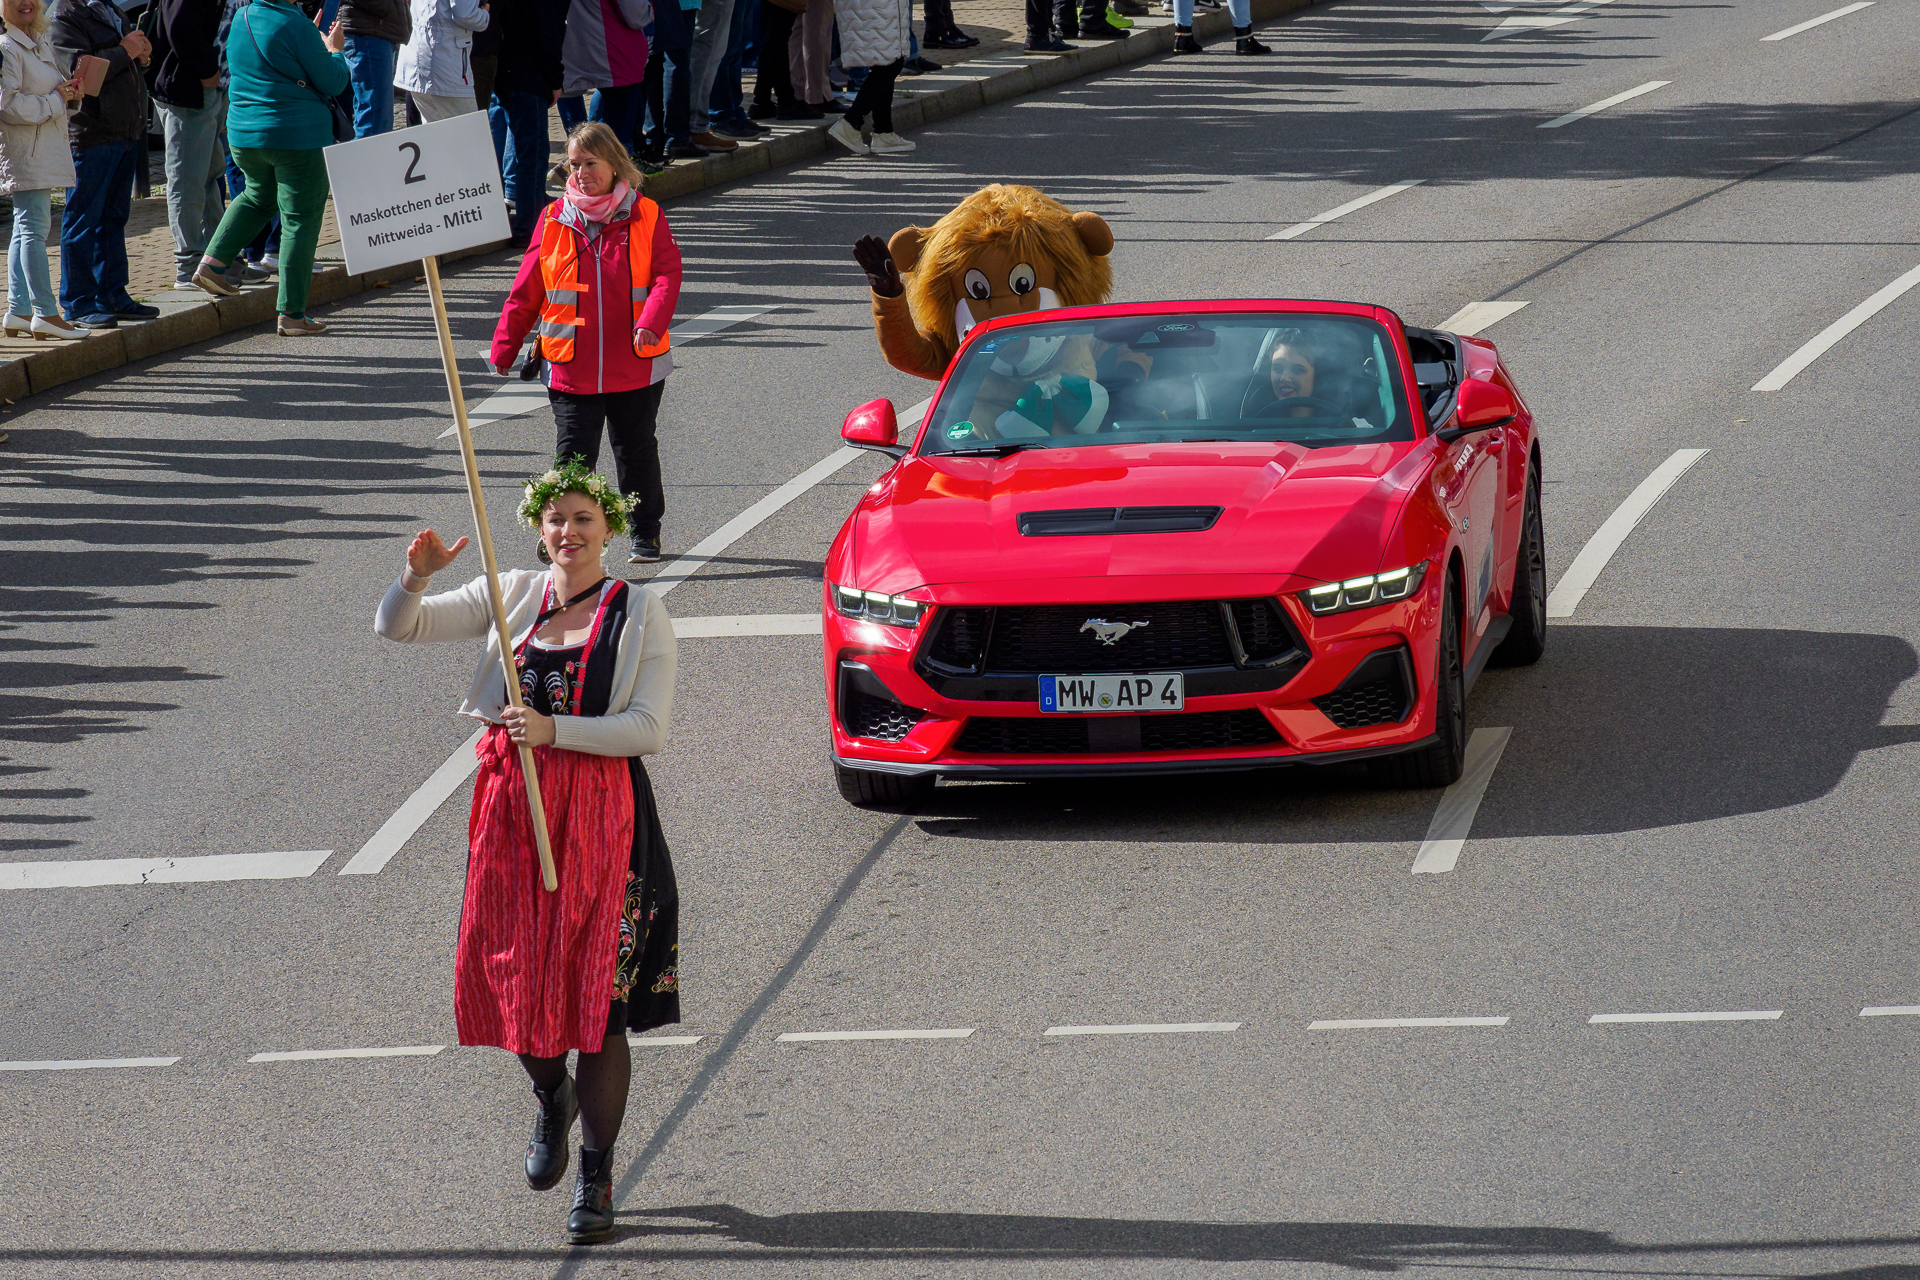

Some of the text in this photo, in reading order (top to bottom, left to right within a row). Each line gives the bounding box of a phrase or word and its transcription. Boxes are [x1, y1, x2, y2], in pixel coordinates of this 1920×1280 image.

[398, 141, 426, 185] 2
[350, 182, 492, 226] Maskottchen der Stadt
[367, 222, 433, 248] Mittweida
[443, 206, 483, 229] Mitti
[1045, 697, 1052, 705] D
[1058, 678, 1177, 707] MW AP 4
